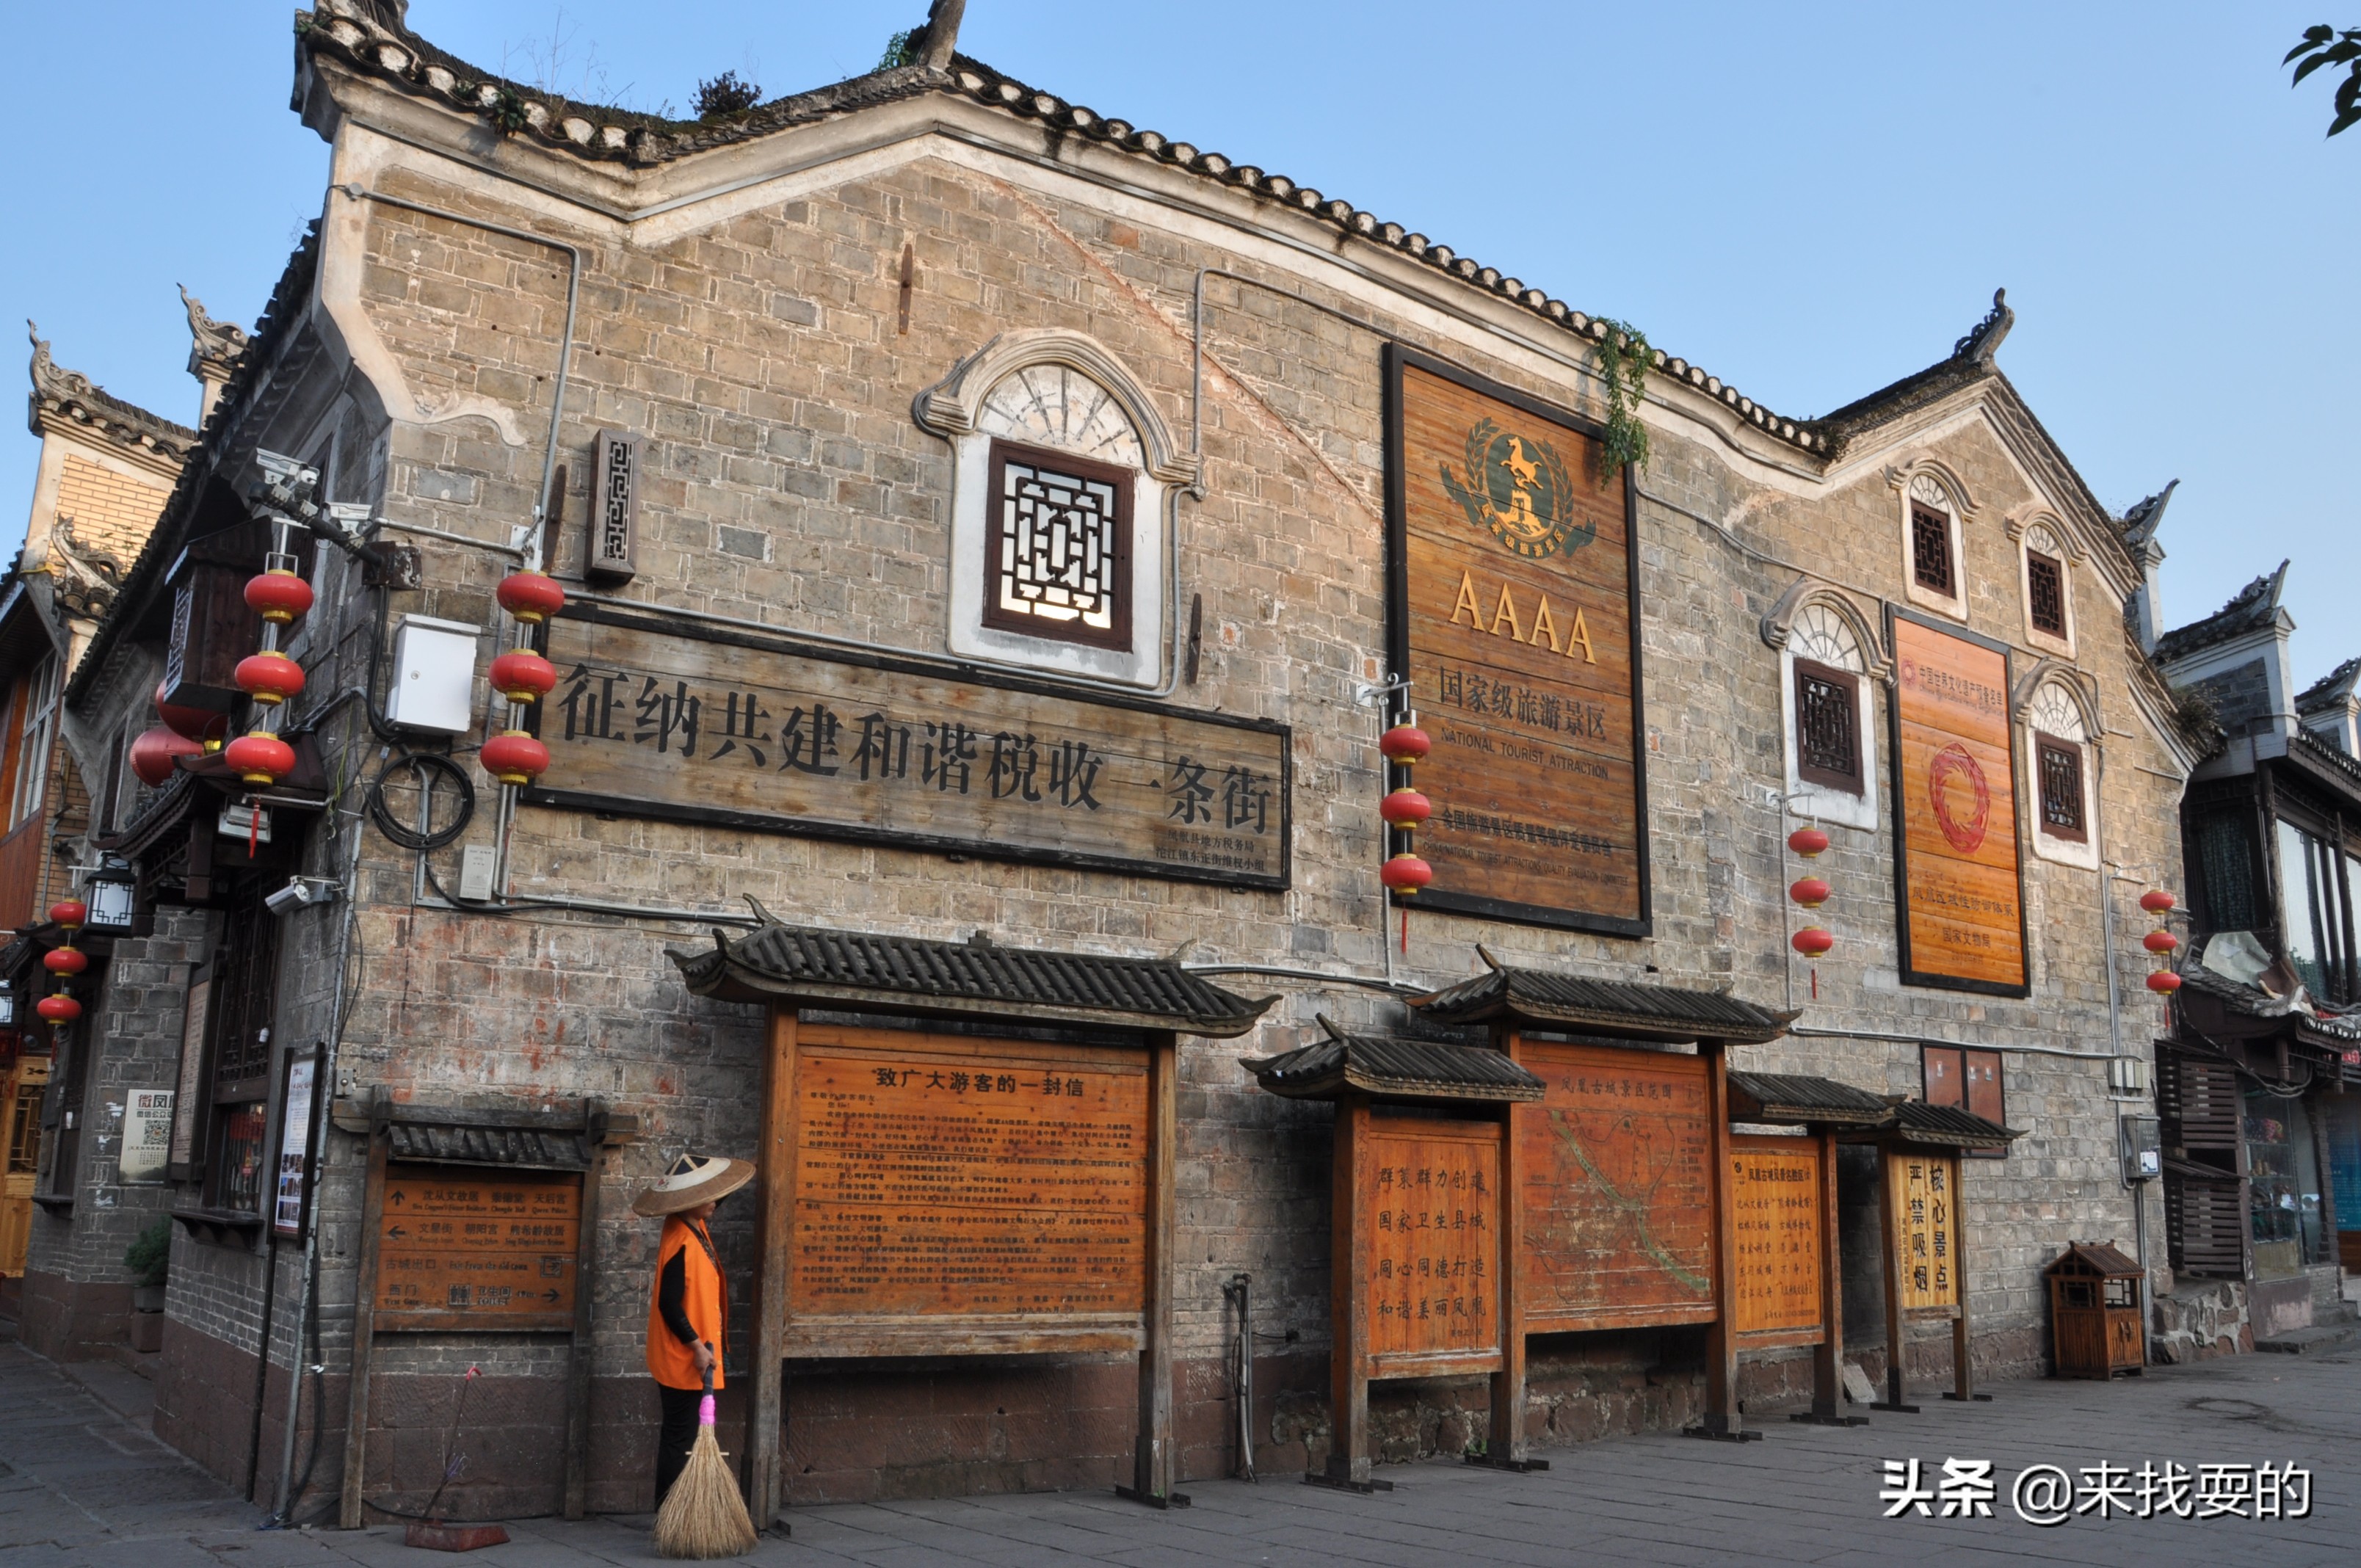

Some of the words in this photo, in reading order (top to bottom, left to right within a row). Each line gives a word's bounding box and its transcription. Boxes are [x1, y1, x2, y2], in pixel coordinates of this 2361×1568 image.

[1449, 570, 1596, 664] AAAA
[1440, 665, 1607, 741] 国家级旅游景区
[558, 663, 1272, 835] 征纳共建和谐税收一条街
[1441, 727, 1495, 753] NATIONAL
[1501, 741, 1544, 764] TOURIST
[1549, 755, 1609, 780] ATTRACTION
[1168, 830, 1255, 853] 凤凰县地方税务局
[1942, 927, 1992, 949] 国家文物局
[875, 1067, 1084, 1097] 致广大游客的一封信
[138, 1094, 173, 1108] 微凤
[1378, 1167, 1487, 1193] 群策群力创建
[423, 1189, 479, 1202] 沈从文故居
[1378, 1210, 1487, 1233] 国家卫生县城
[1909, 1164, 1928, 1292] 严禁吸烟
[1929, 1164, 1948, 1291] 核心景点
[386, 1257, 437, 1271] 古城出口
[1379, 1255, 1487, 1280] 同心同德打造
[389, 1283, 418, 1296] 西门
[476, 1285, 512, 1297] 卫生间
[1377, 1296, 1487, 1321] 和谐美丽凤凰
